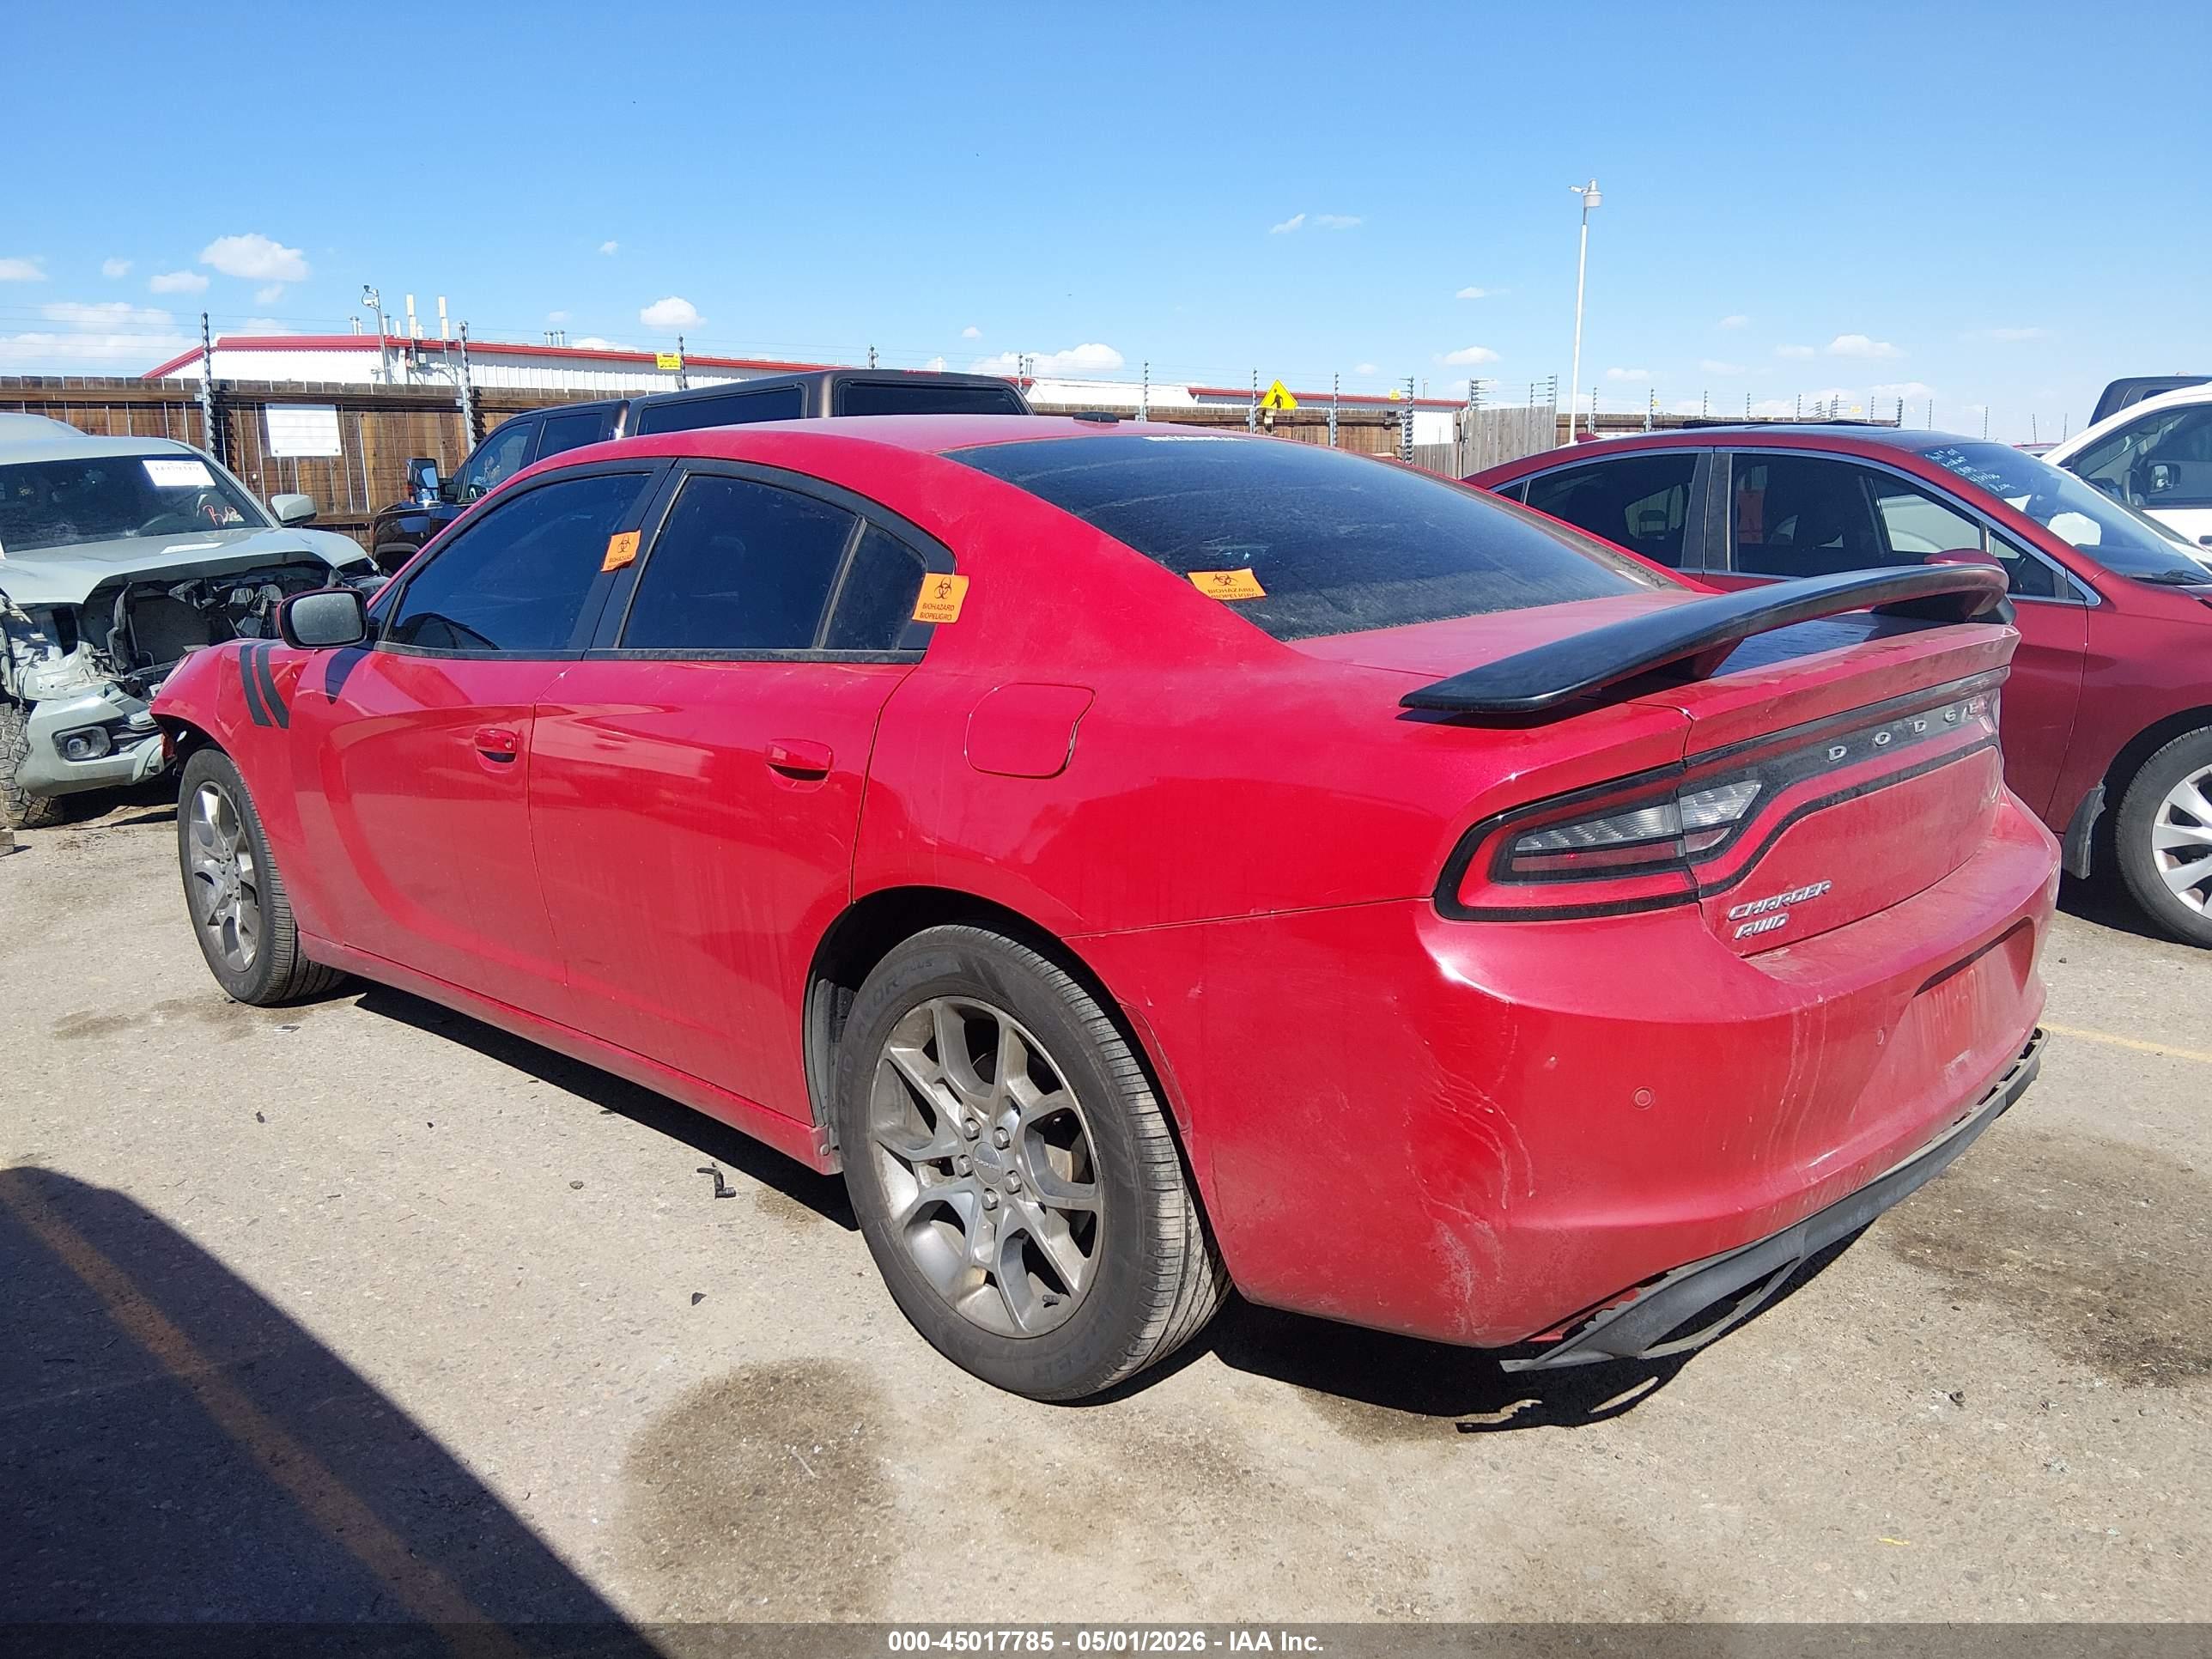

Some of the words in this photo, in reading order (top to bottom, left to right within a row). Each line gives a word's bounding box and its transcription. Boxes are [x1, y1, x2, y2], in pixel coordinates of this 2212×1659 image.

[920, 611, 952, 621] BIOPELIGRO
[922, 603, 955, 611] BIOHAZARD
[1827, 701, 1979, 762] DODGE
[1728, 879, 1832, 921] CHARGER
[1734, 912, 1790, 940] AWD
